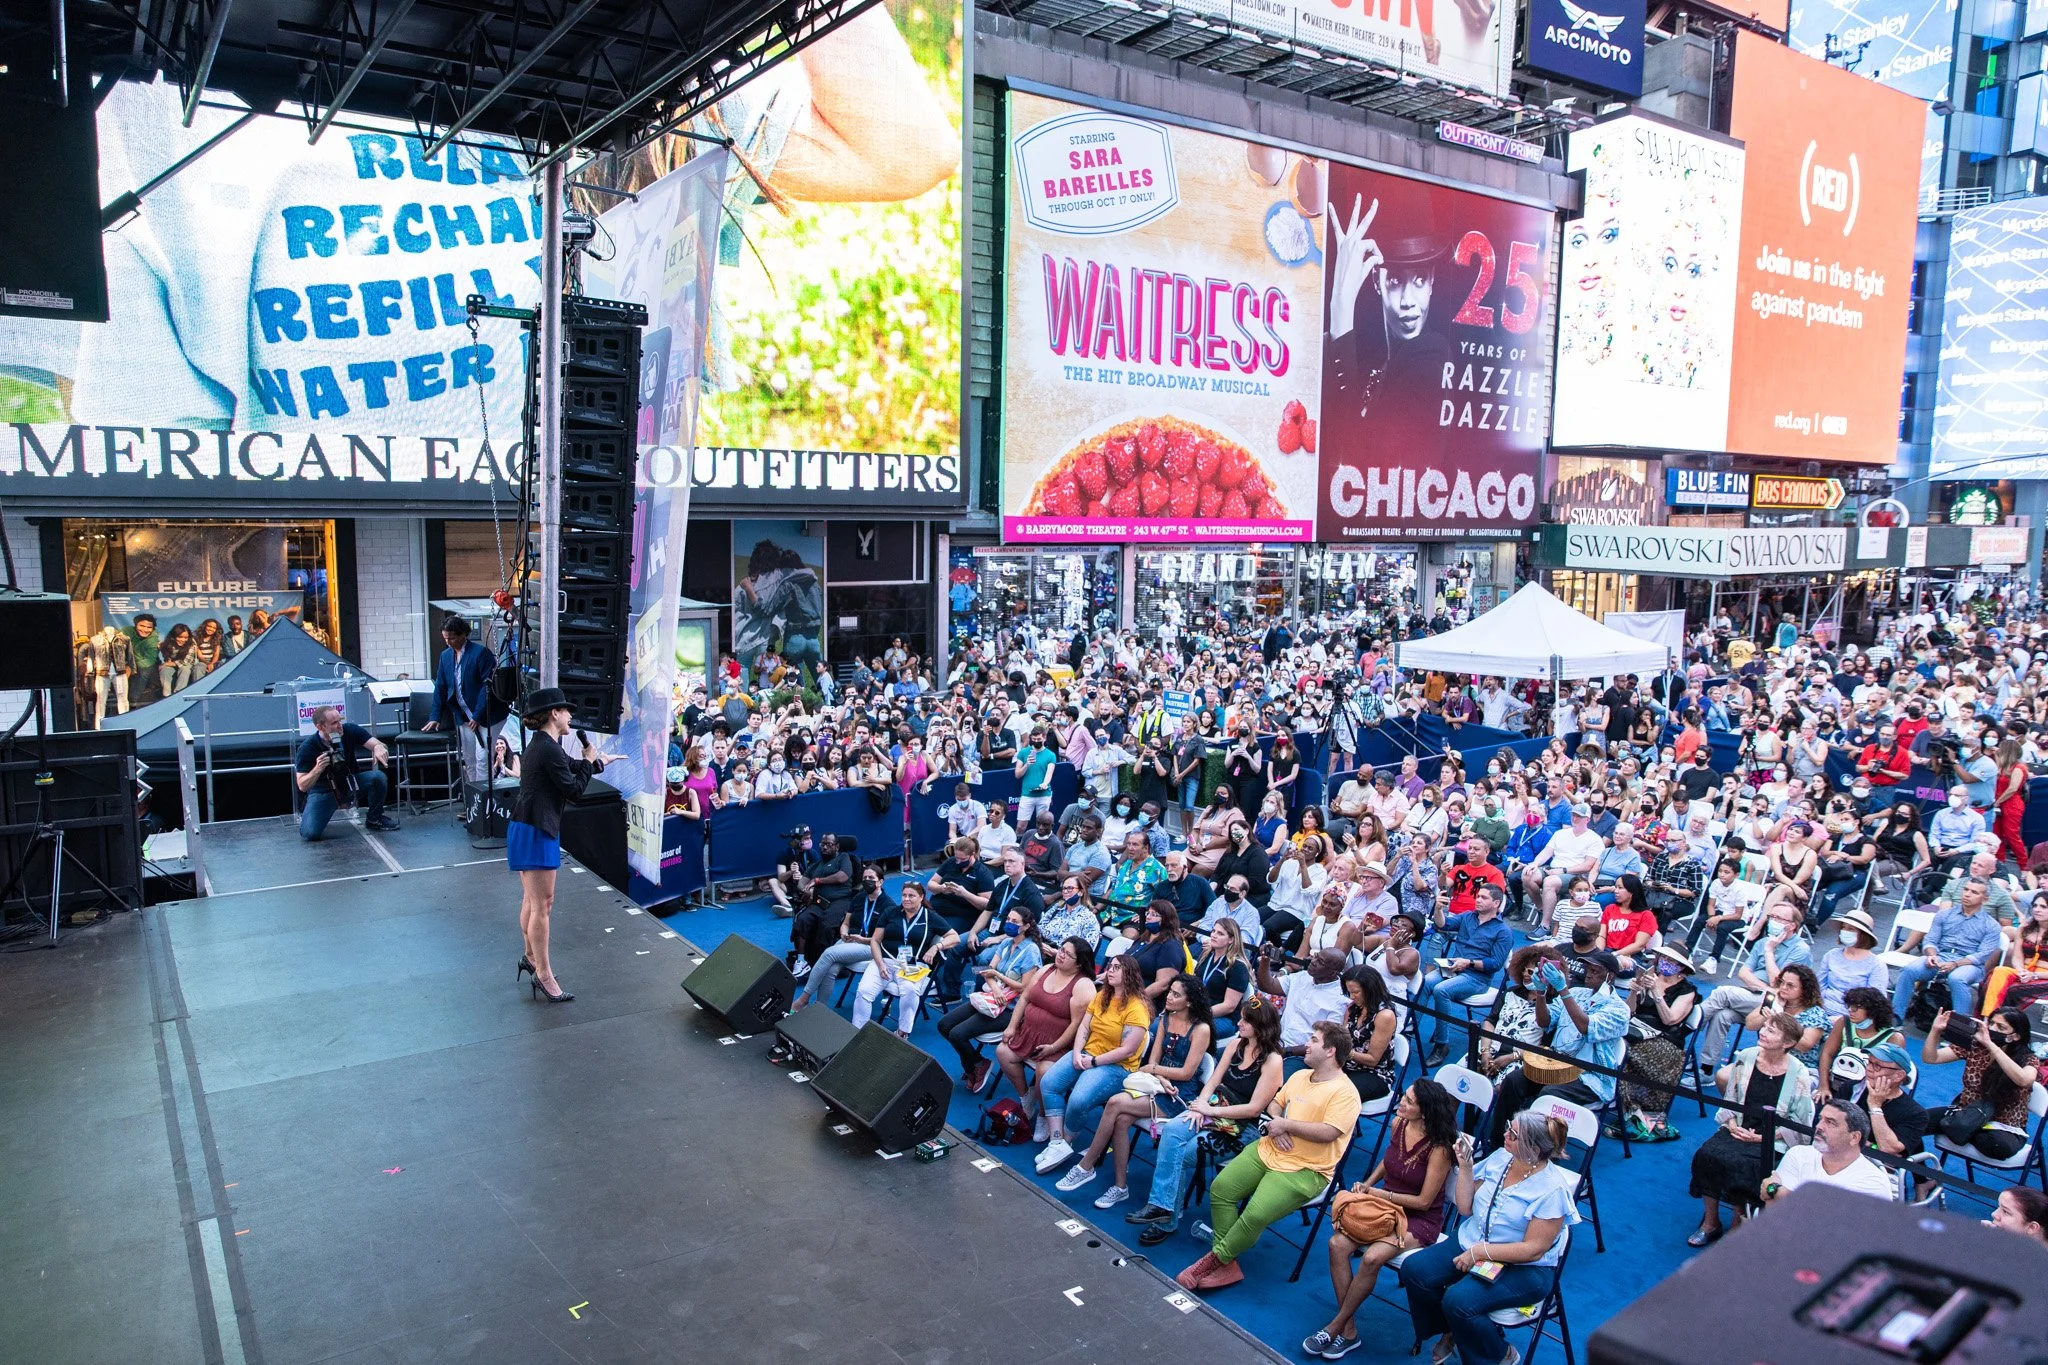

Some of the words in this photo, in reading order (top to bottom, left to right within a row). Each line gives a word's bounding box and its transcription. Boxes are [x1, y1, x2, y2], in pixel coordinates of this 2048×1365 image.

[1311, 15, 1333, 31] WALTER
[1334, 21, 1350, 37] KERR
[1378, 34, 1390, 47] 219
[1544, 25, 1632, 65] ARCIMOTO
[1843, 13, 1909, 48] Stanley
[1892, 45, 1953, 74] Stanle
[1069, 133, 1116, 146] STARRING
[1443, 124, 1505, 152] OUTFRONT
[1510, 143, 1542, 161] PRIME
[346, 131, 523, 186] RELA
[1069, 147, 1123, 170] SARA
[1044, 168, 1154, 199] BAREILLES
[1800, 139, 1860, 237] (RED)
[1049, 199, 1095, 214] THROUGH
[1096, 197, 1115, 209] OCT
[1119, 195, 1127, 205] 17
[1130, 191, 1156, 204] ONLY!
[282, 195, 542, 260] RECHA
[2010, 247, 2048, 260] Stan
[1451, 230, 1541, 335] 25
[1756, 245, 1791, 276] Join
[1793, 259, 1811, 281] us
[1813, 257, 1827, 284] in
[1829, 261, 1852, 289] the
[1854, 266, 1885, 300] fight
[19, 288, 60, 297] PROMOBILE
[254, 268, 515, 344] REFILL
[1043, 253, 1290, 378] WAITRESS
[1751, 289, 1805, 319] against
[1806, 300, 1863, 329] pandem
[1460, 341, 1503, 359] YEARS
[1510, 348, 1527, 362] OF
[252, 343, 496, 421] WATER
[1064, 365, 1093, 382] THE
[1097, 368, 1123, 384] HIT
[1128, 372, 1208, 391] BROADWAY
[1211, 379, 1271, 397] MUSICAL
[1441, 361, 1539, 398] RAZZLE
[1439, 398, 1539, 434] DAZZLE
[1774, 410, 1811, 436] red.org
[3, 422, 397, 483] MERICAN
[644, 445, 959, 492] OUTFITTERS
[1329, 465, 1537, 520] CHICAGO
[1678, 470, 1718, 493] BLUE
[1724, 473, 1749, 493] FIN
[1757, 479, 1779, 503] DOS
[1782, 481, 1828, 505] CAMINOS
[1025, 524, 1084, 535] BARRYMORE
[1086, 525, 1127, 536] THEATRE
[1133, 525, 1149, 536] 243
[1150, 525, 1159, 536] W.
[1178, 525, 1189, 536] ST.
[1195, 525, 1303, 536] WAITRESSTHEMUSICAL.COM
[1570, 507, 1641, 526] SWAROVSKI
[1348, 527, 1381, 537] AMBASSADOR
[1382, 527, 1401, 537] THEATRE
[1405, 528, 1417, 537] 49TH
[1418, 528, 1434, 537] STREET
[1435, 528, 1440, 537] AT
[1441, 528, 1465, 537] BROADWAY
[1468, 528, 1522, 538] CHICAGOTHEMUSICAL.COM
[1569, 534, 1725, 564] SWAROVSKI
[1730, 534, 1843, 567] SWAROVSKI
[1161, 553, 1256, 583] GRAND
[1306, 552, 1377, 581] SLAM
[157, 580, 258, 594] FUTURE
[139, 596, 275, 610] TOGETHER
[1552, 1103, 1576, 1121] CURTAIN
[1174, 1296, 1188, 1306] 8
